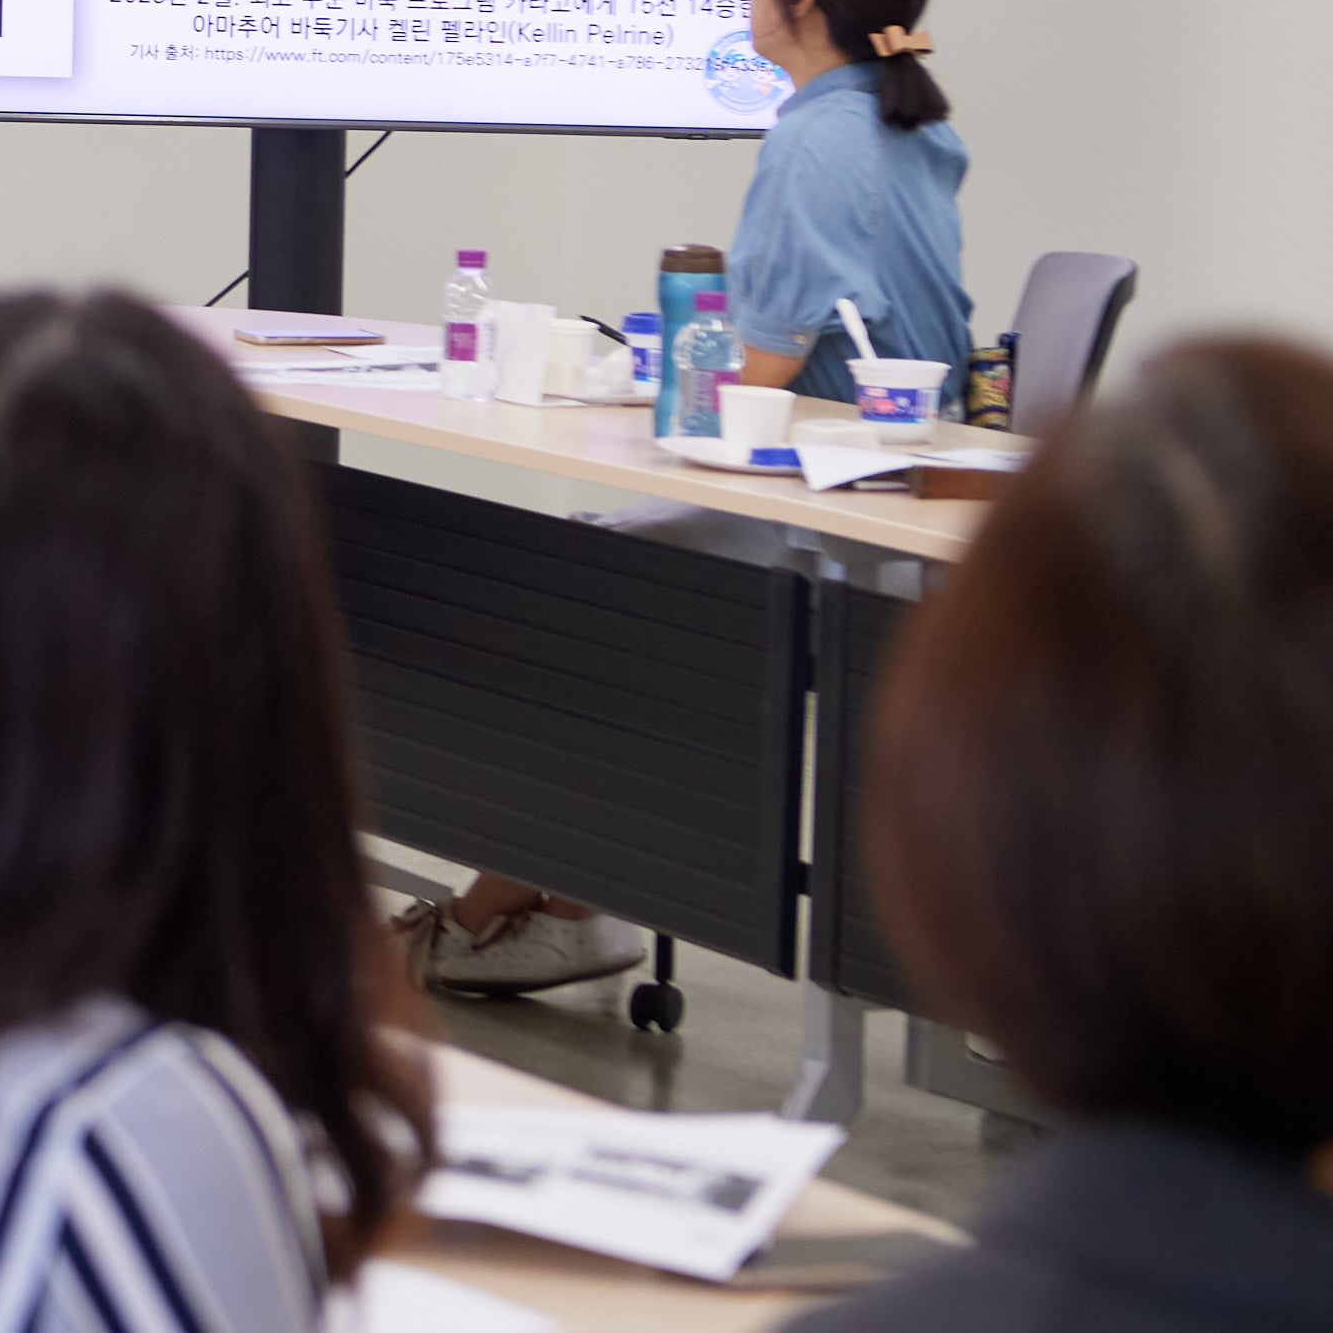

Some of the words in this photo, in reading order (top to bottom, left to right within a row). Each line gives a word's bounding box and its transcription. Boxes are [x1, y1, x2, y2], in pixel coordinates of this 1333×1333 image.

[192, 14, 281, 40] 아마추어
[290, 16, 380, 42] 바둑기사
[388, 18, 431, 43] 켈린
[440, 19, 578, 46] 펠라인(Kellin
[587, 23, 675, 48] Pelrine)
[129, 43, 160, 61] 기사
[164, 43, 200, 62] 출처:
